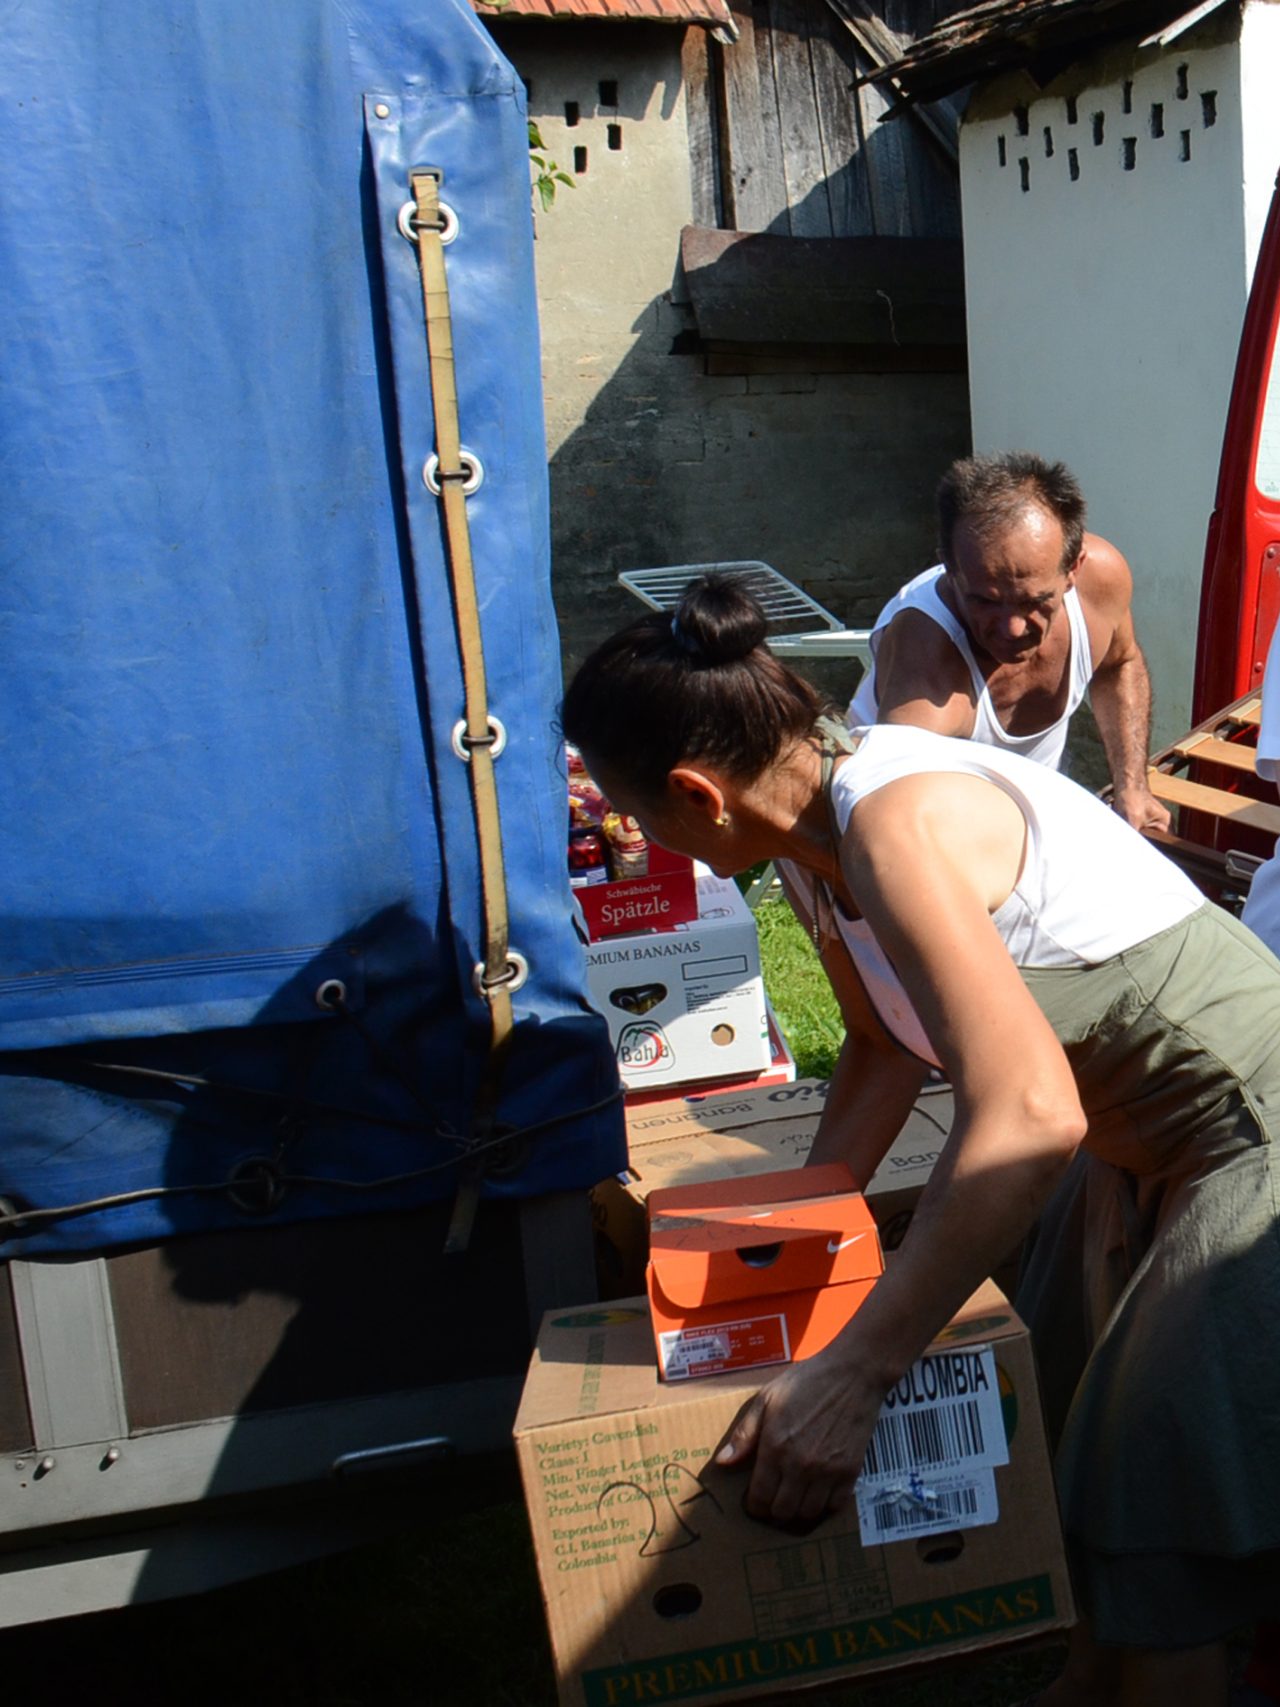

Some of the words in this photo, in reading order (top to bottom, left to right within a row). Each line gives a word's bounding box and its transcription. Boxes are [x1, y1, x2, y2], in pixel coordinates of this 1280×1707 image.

[606, 883, 662, 899] Schwäbische
[601, 896, 670, 926] Spätzle
[586, 949, 630, 966] EMIUM
[633, 940, 702, 961] BANANAS
[631, 1102, 753, 1130] Bananen
[536, 1437, 589, 1455] Variety:
[592, 1422, 658, 1445] Cavendish
[539, 1455, 580, 1471] Class:
[543, 1472, 573, 1487] Min.
[576, 1463, 617, 1482] Finger
[621, 1453, 669, 1472] Length:
[672, 1448, 688, 1462] 20
[691, 1447, 711, 1458] cm
[546, 1487, 574, 1503] Net.
[549, 1499, 602, 1518] Product
[552, 1520, 608, 1541] Exported
[611, 1515, 630, 1531] by:
[558, 1552, 617, 1573] Colombia
[605, 1637, 818, 1705] PREMIUM
[832, 1588, 1038, 1658] BANANAS
